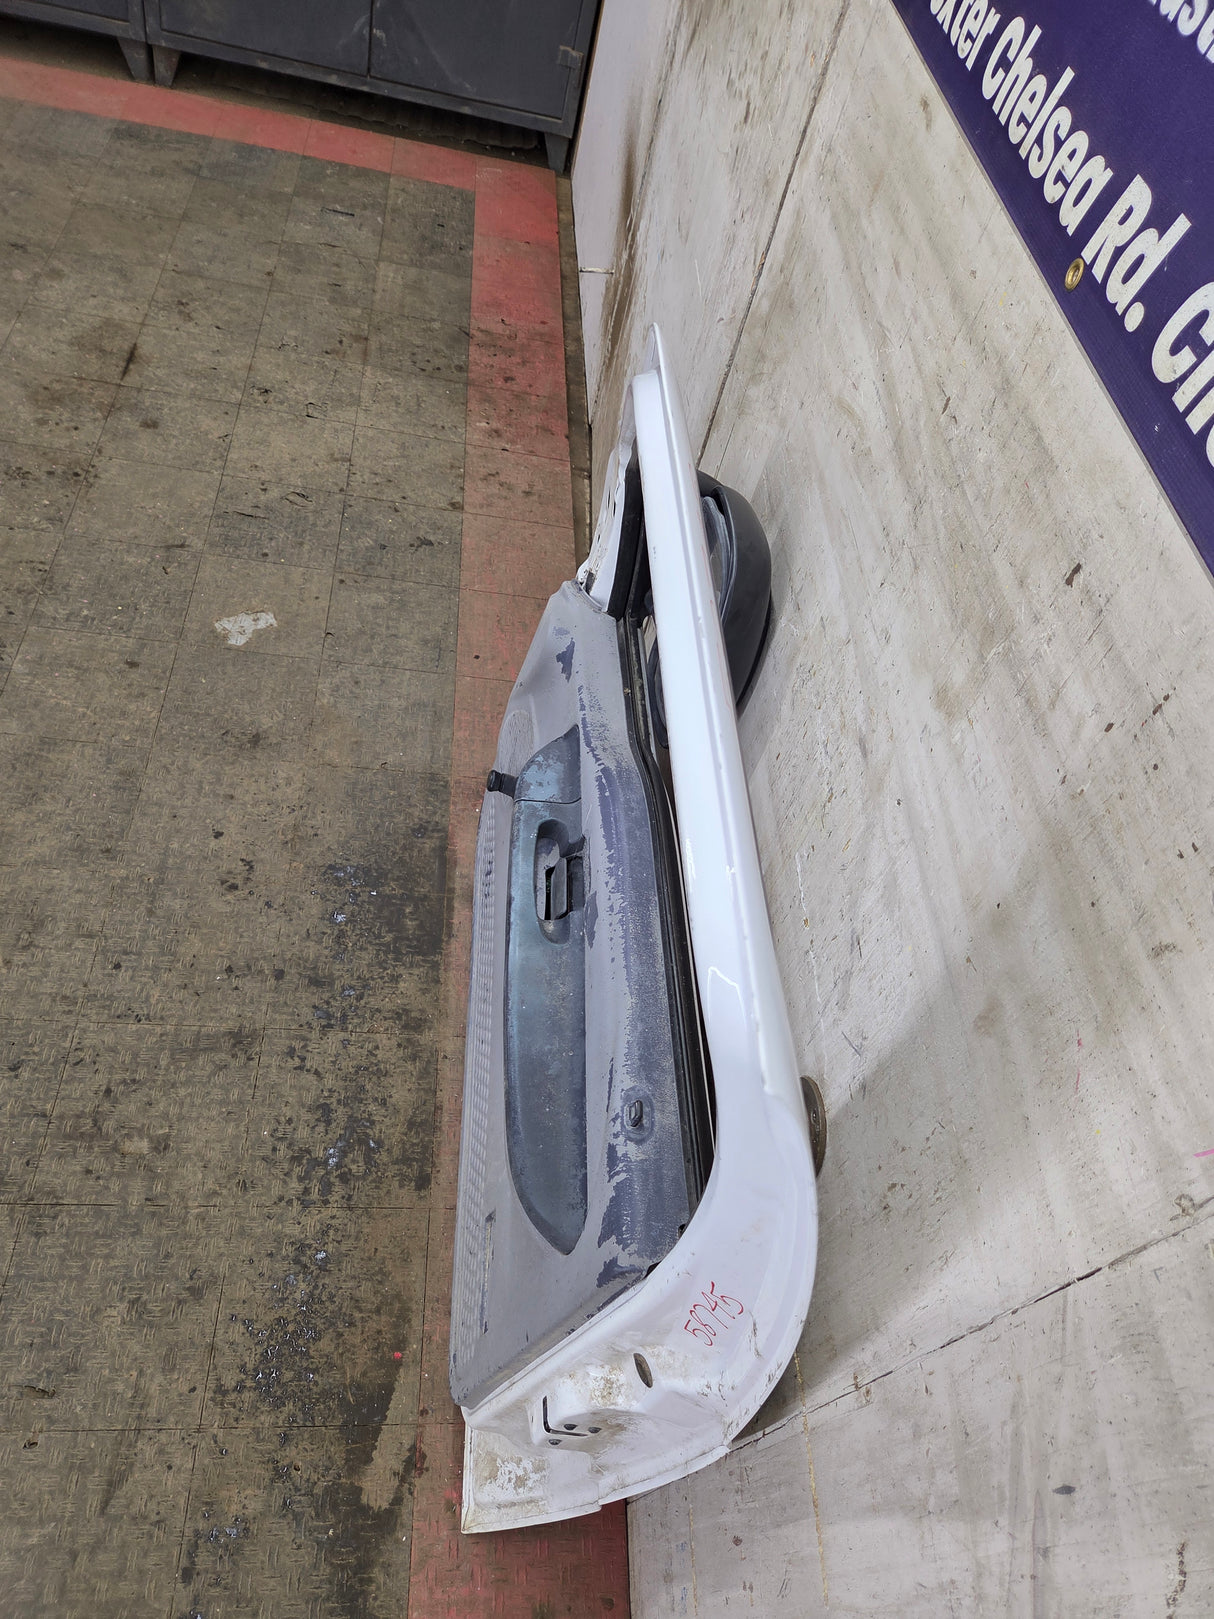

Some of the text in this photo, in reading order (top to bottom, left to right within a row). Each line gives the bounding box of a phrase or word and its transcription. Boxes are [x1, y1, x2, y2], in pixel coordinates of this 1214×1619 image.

[930, 0, 1001, 72] xter
[982, 16, 1114, 236] Chelsea
[1081, 174, 1192, 333] Rd.
[684, 1281, 744, 1346] 58745
